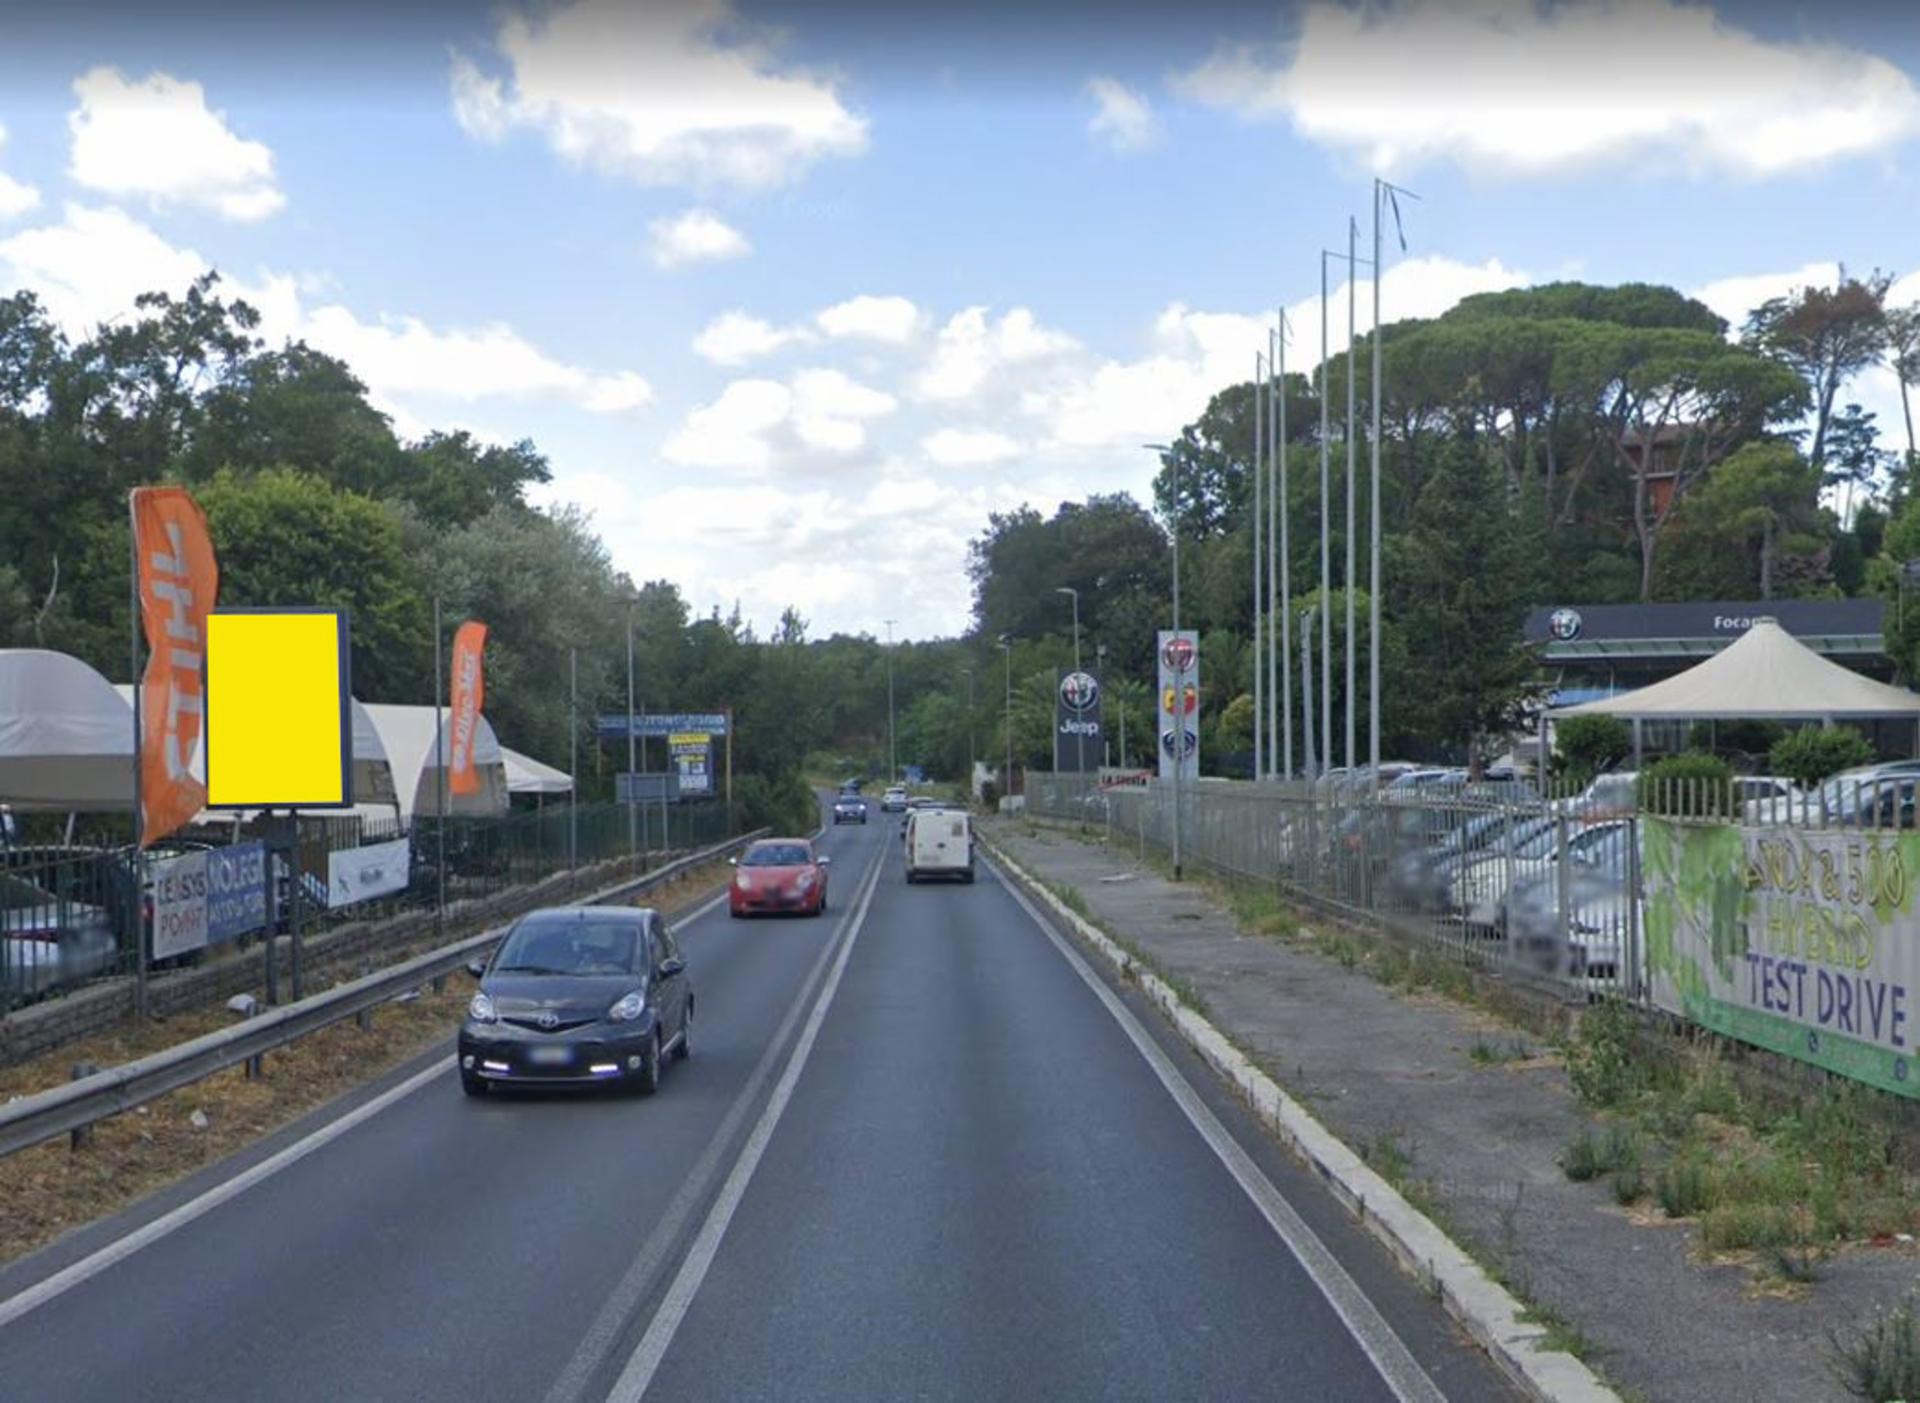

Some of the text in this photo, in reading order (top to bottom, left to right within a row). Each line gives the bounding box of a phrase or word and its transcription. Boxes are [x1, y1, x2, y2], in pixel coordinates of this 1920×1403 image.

[1060, 718, 1098, 737] Jeep
[1848, 844, 1905, 908] 500
[1746, 954, 1906, 1046] TEST DRIVE
